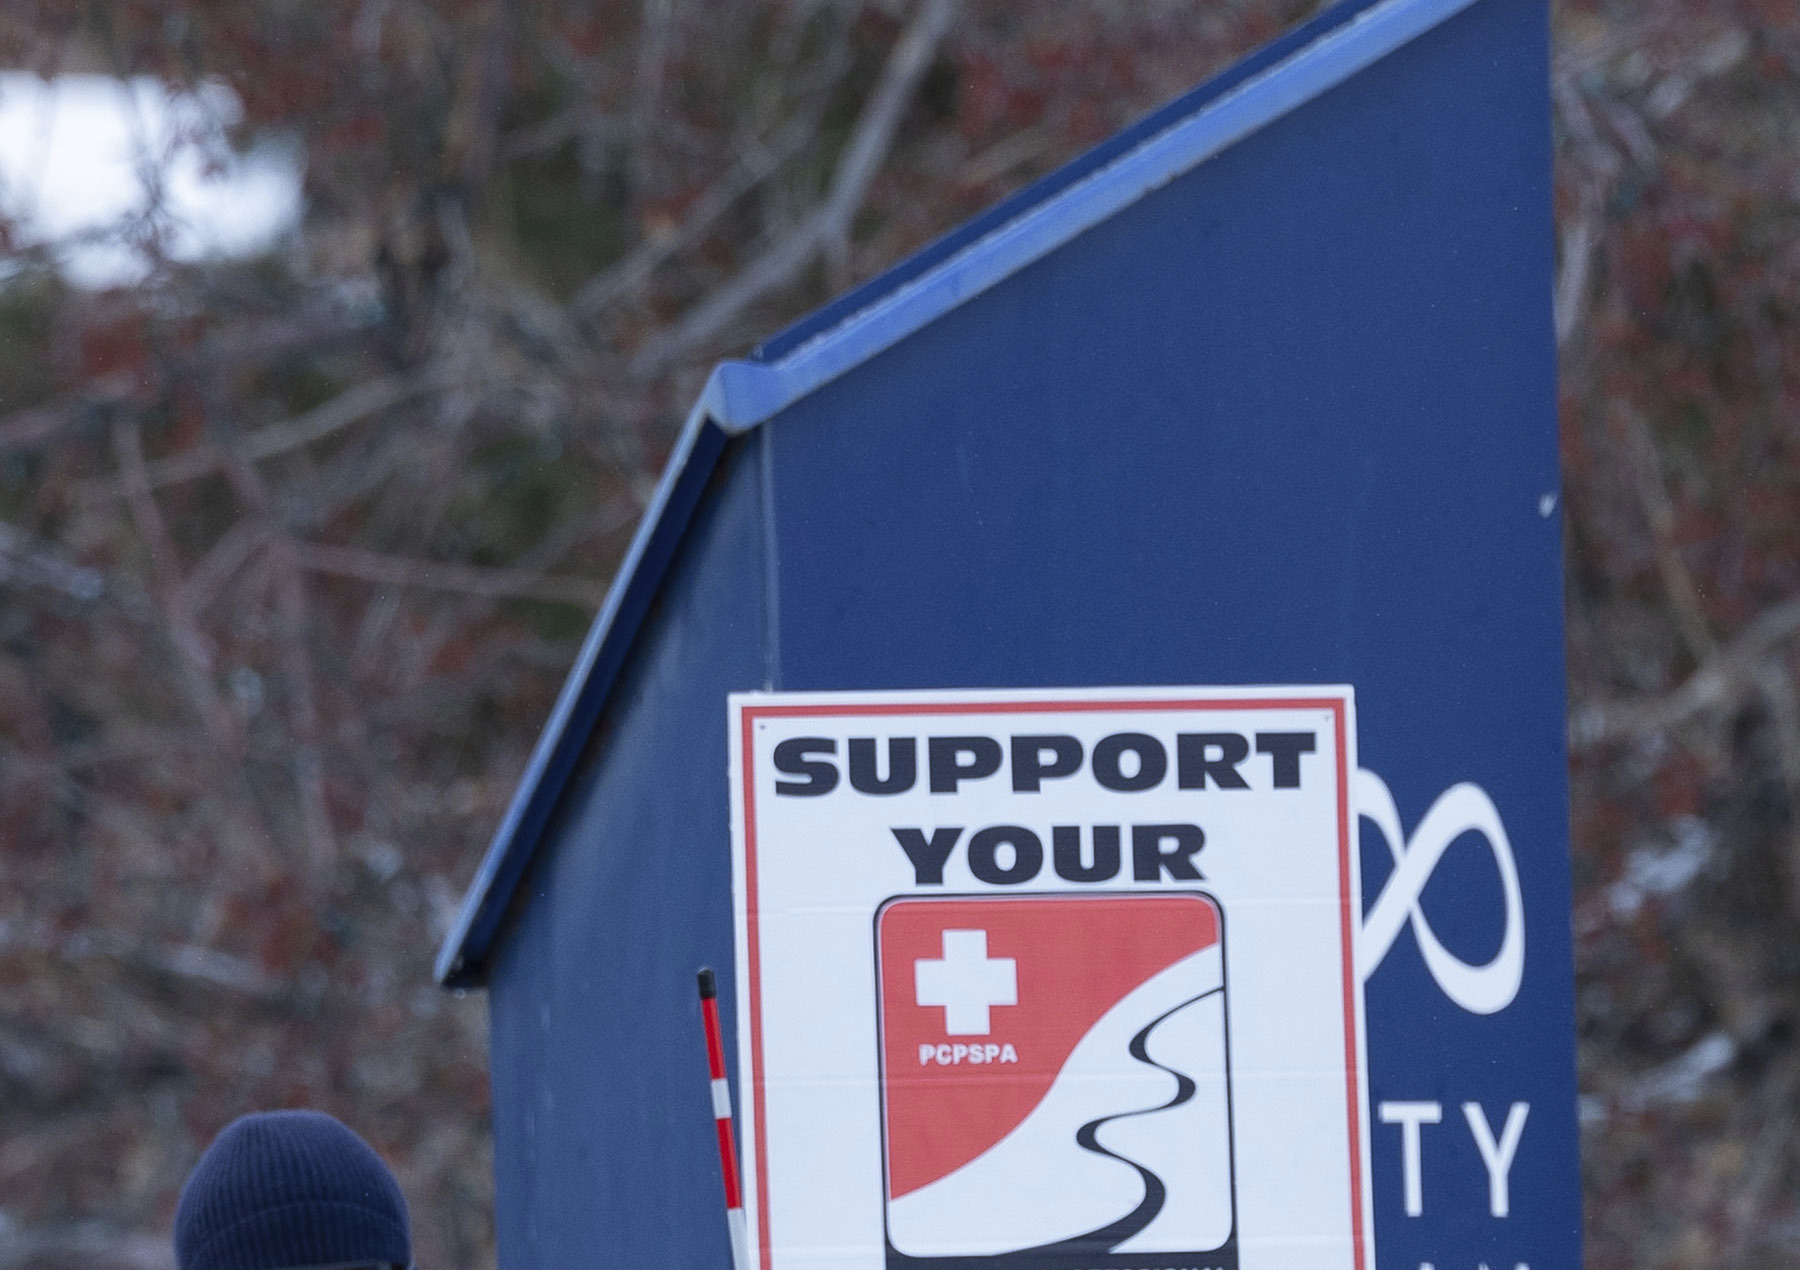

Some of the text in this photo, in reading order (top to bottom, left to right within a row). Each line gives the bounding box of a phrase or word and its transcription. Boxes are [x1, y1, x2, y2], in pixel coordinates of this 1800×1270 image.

[773, 731, 1319, 797] SUPPORT
[891, 823, 1208, 886] YOUR
[919, 1044, 1017, 1066] PCPSPA
